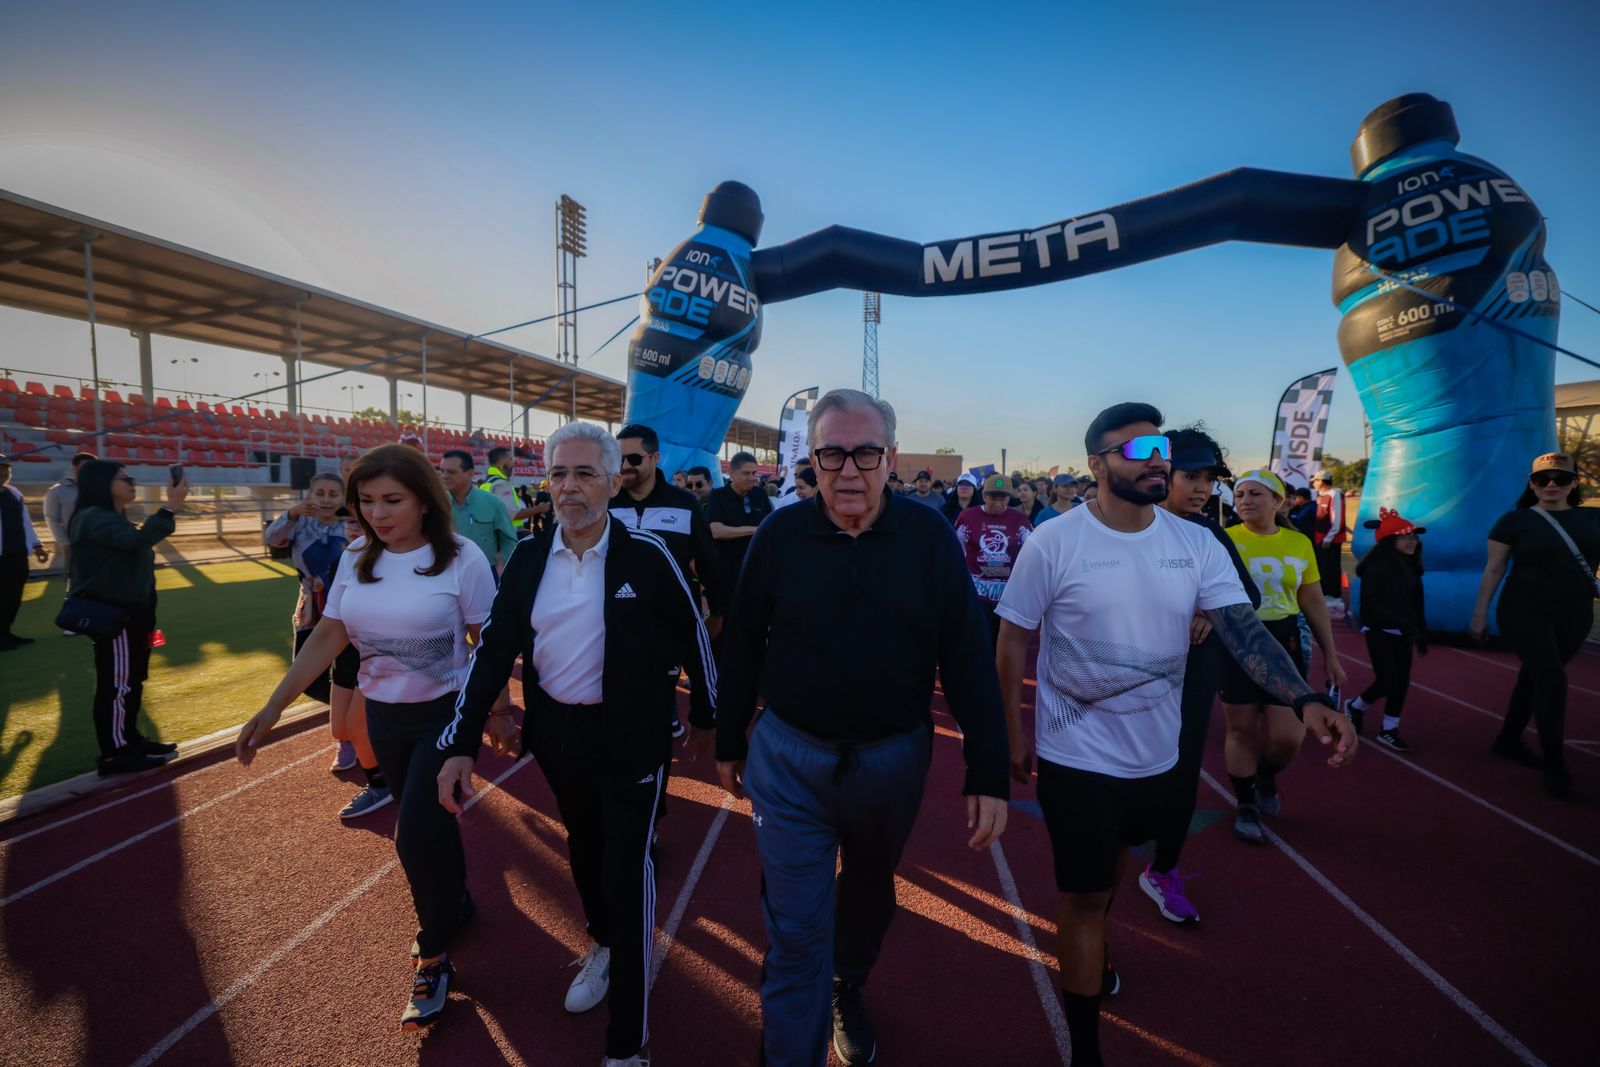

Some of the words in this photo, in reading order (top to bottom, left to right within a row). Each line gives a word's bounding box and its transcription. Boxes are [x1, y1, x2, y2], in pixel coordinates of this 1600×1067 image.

[1366, 179, 1531, 247] POWE
[923, 213, 1120, 284] META
[654, 266, 759, 319] POWER
[1398, 304, 1430, 325] 600
[642, 348, 658, 362] 600
[1287, 411, 1314, 459] ISDE
